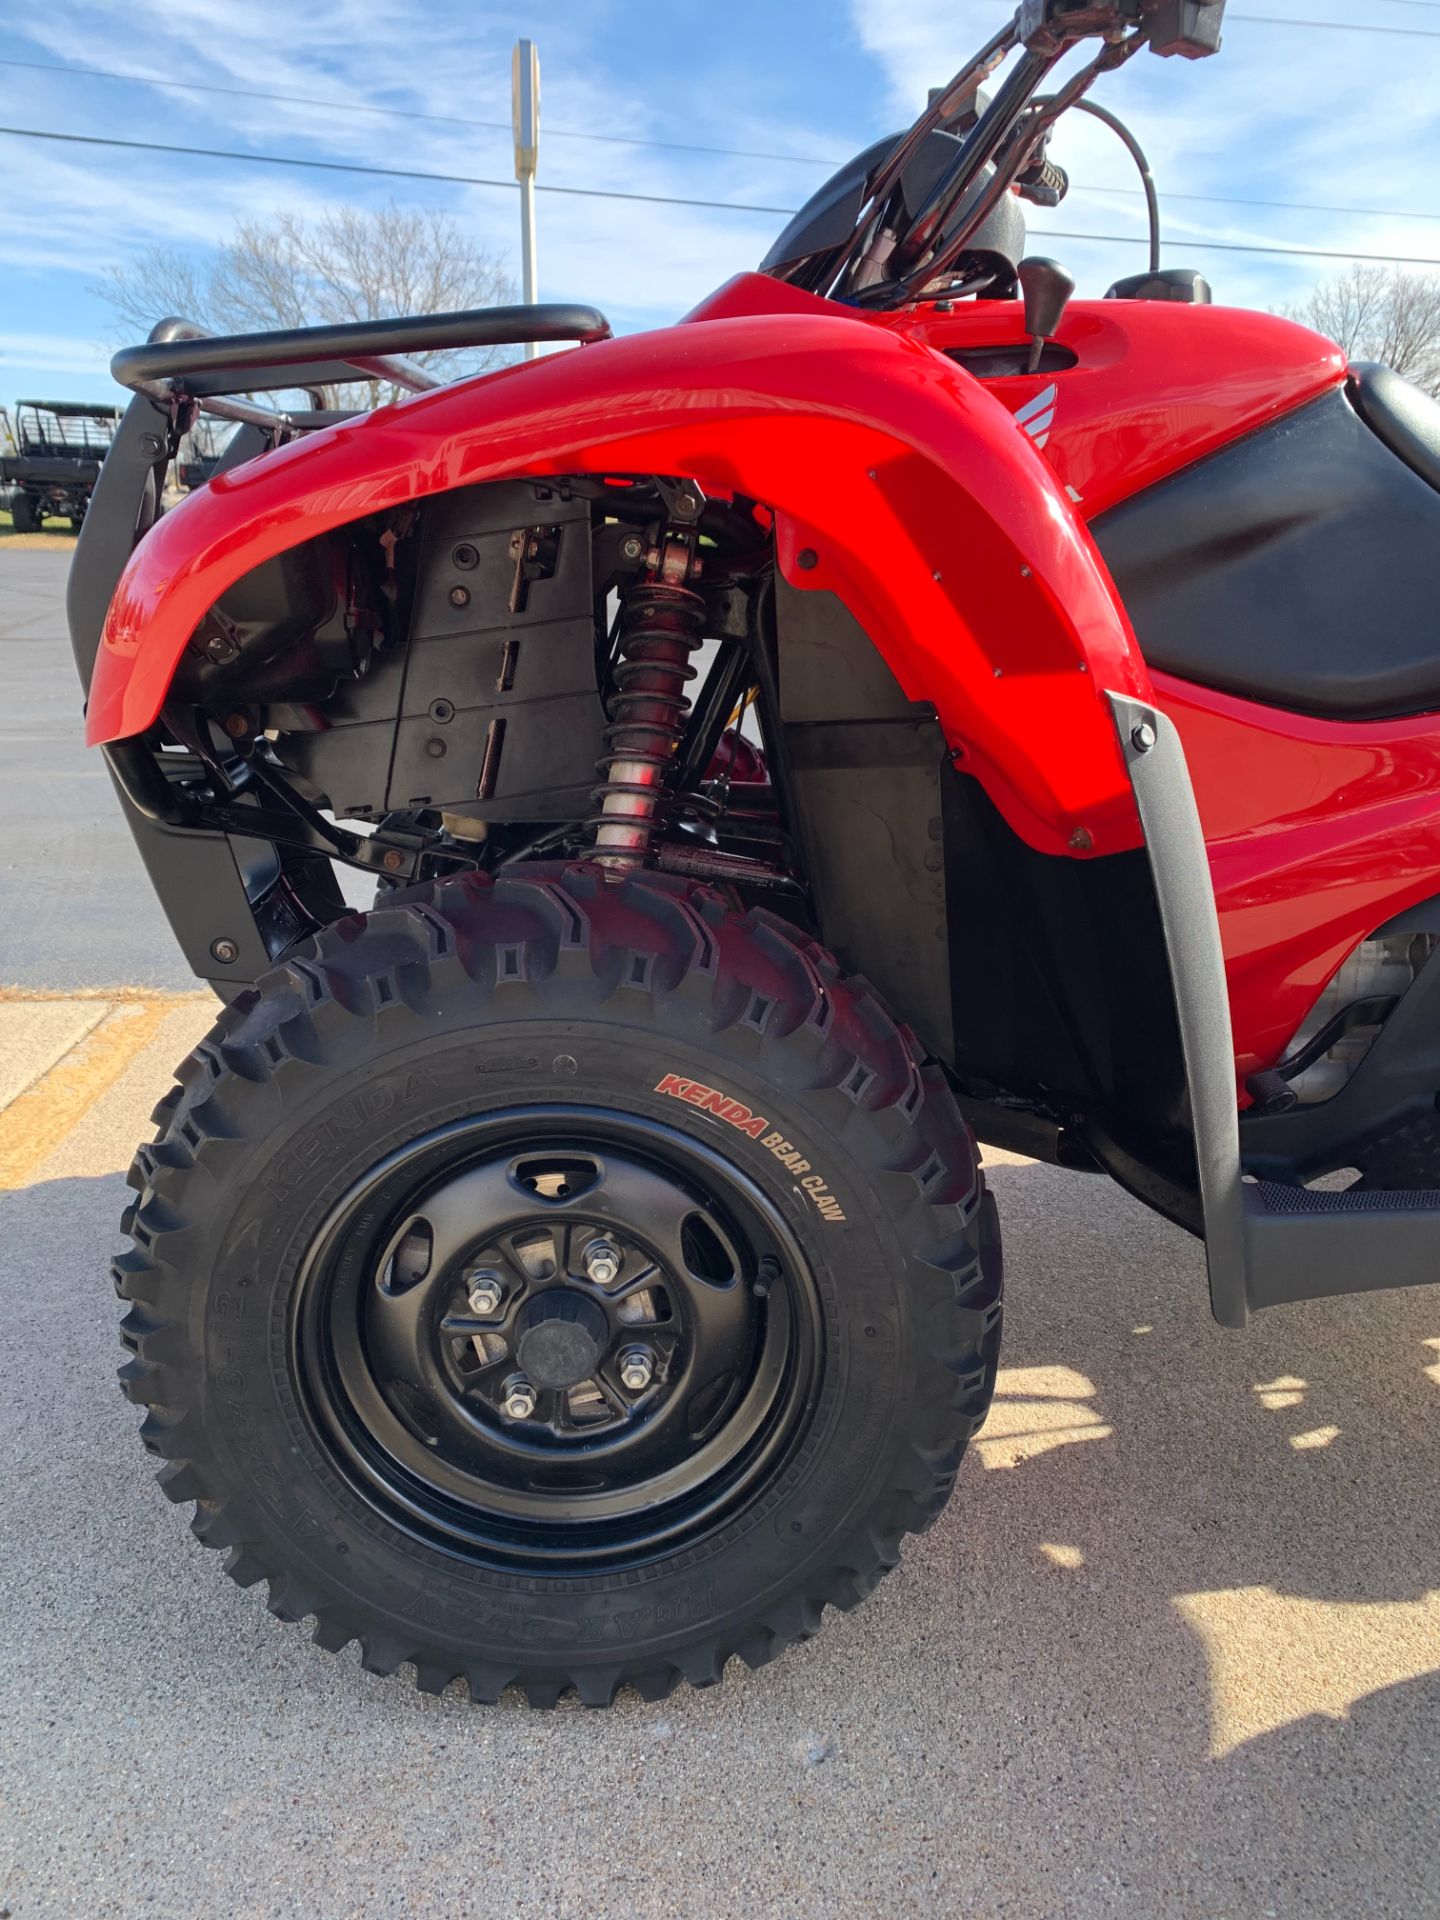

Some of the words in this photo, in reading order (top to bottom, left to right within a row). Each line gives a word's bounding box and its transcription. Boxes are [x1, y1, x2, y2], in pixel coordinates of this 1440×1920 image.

[263, 1068, 440, 1202] KENDA
[654, 1073, 770, 1139] KENDA
[760, 1131, 810, 1176] BEAR
[801, 1175, 847, 1222] CLAW
